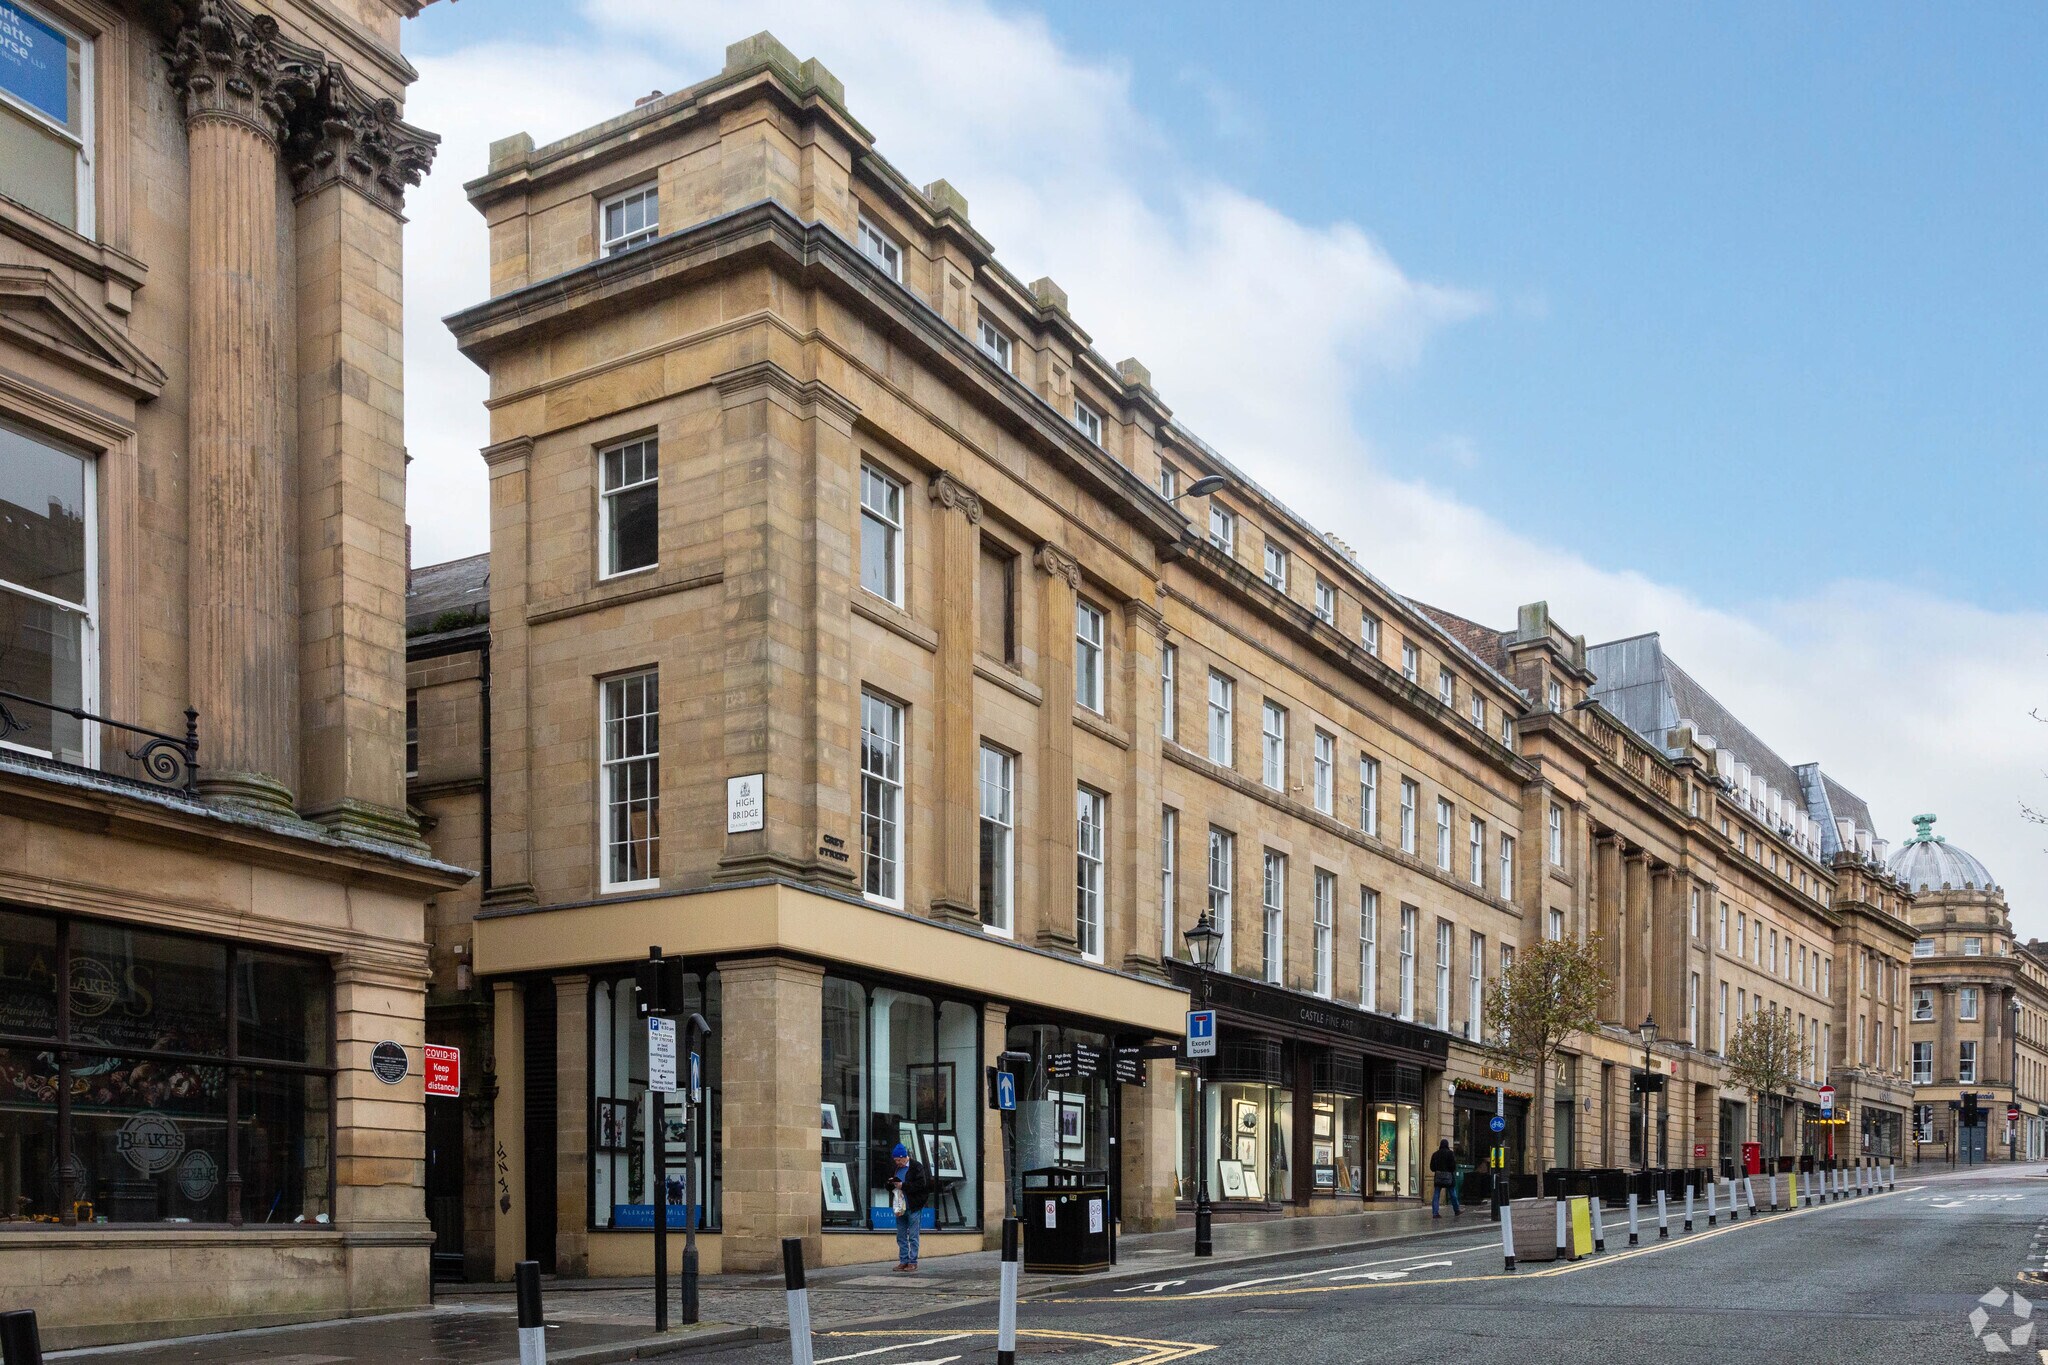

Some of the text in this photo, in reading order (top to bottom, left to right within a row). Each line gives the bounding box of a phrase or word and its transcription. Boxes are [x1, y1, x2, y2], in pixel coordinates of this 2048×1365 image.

[736, 798, 755, 808] HIGH
[732, 808, 759, 820] BRIDGE
[823, 834, 845, 848] GREY
[819, 846, 850, 862] STREET
[1300, 1008, 1354, 1030] CASTLE FINE ART
[1192, 1040, 1211, 1048] Except
[426, 1048, 457, 1060] COVID-19
[433, 1063, 450, 1073] Keep
[428, 1082, 455, 1092] distance
[118, 1131, 184, 1150] BLAKES
